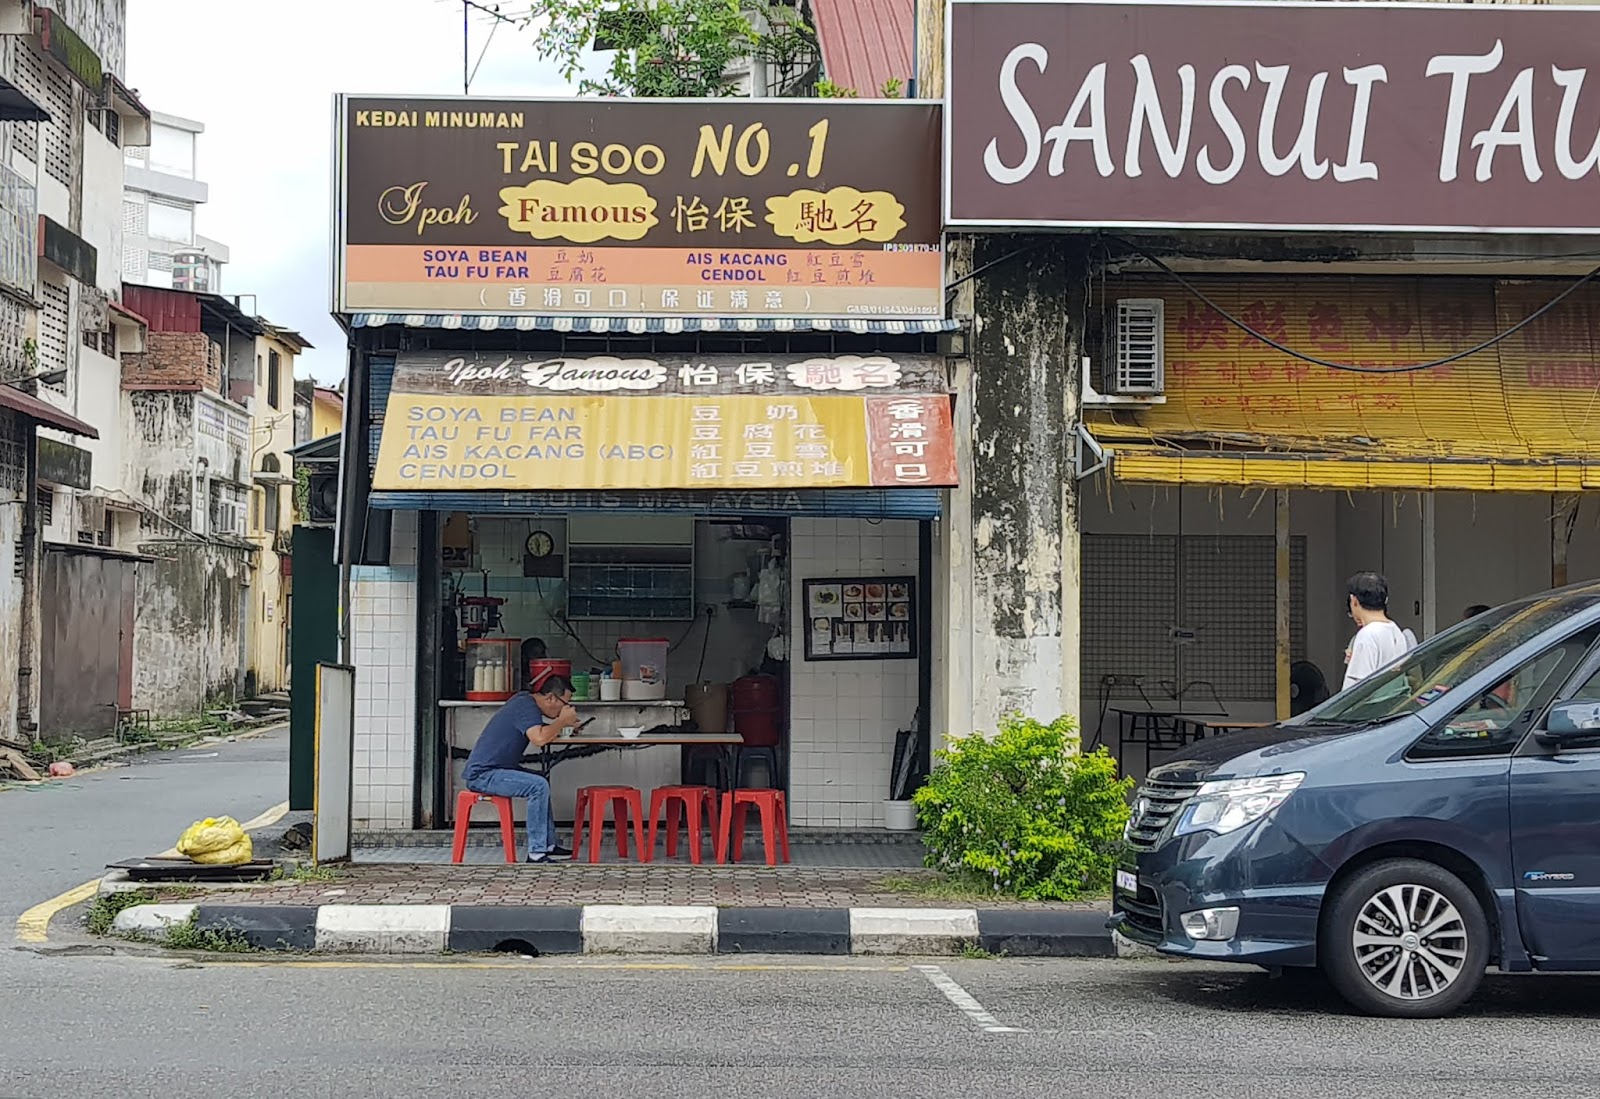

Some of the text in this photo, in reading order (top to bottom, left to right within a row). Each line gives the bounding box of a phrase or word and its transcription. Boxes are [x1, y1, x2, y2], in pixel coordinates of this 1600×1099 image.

[356, 110, 525, 129] KEDAI MINUMAN
[984, 38, 1600, 185] SANSUI TAU
[496, 140, 559, 174] TAI
[570, 141, 666, 175] SOO
[377, 181, 648, 236] Ipoh Famous
[669, 195, 757, 234] 怡保
[795, 198, 879, 235] 馳名
[423, 250, 528, 263] SOYA BEAN
[552, 248, 595, 264] 豆奶
[686, 252, 788, 267] AIS KACANG
[425, 266, 530, 279] TAU FU FAR
[701, 269, 766, 282] CENDOL
[444, 357, 655, 386] Ipoh Famous
[678, 362, 776, 387] 怡保
[407, 406, 576, 423] SOYA BEAN
[406, 425, 583, 441] TAU FU FAR
[402, 444, 674, 461] AIS KACANG (ABC)
[399, 463, 517, 480] CENDOL
